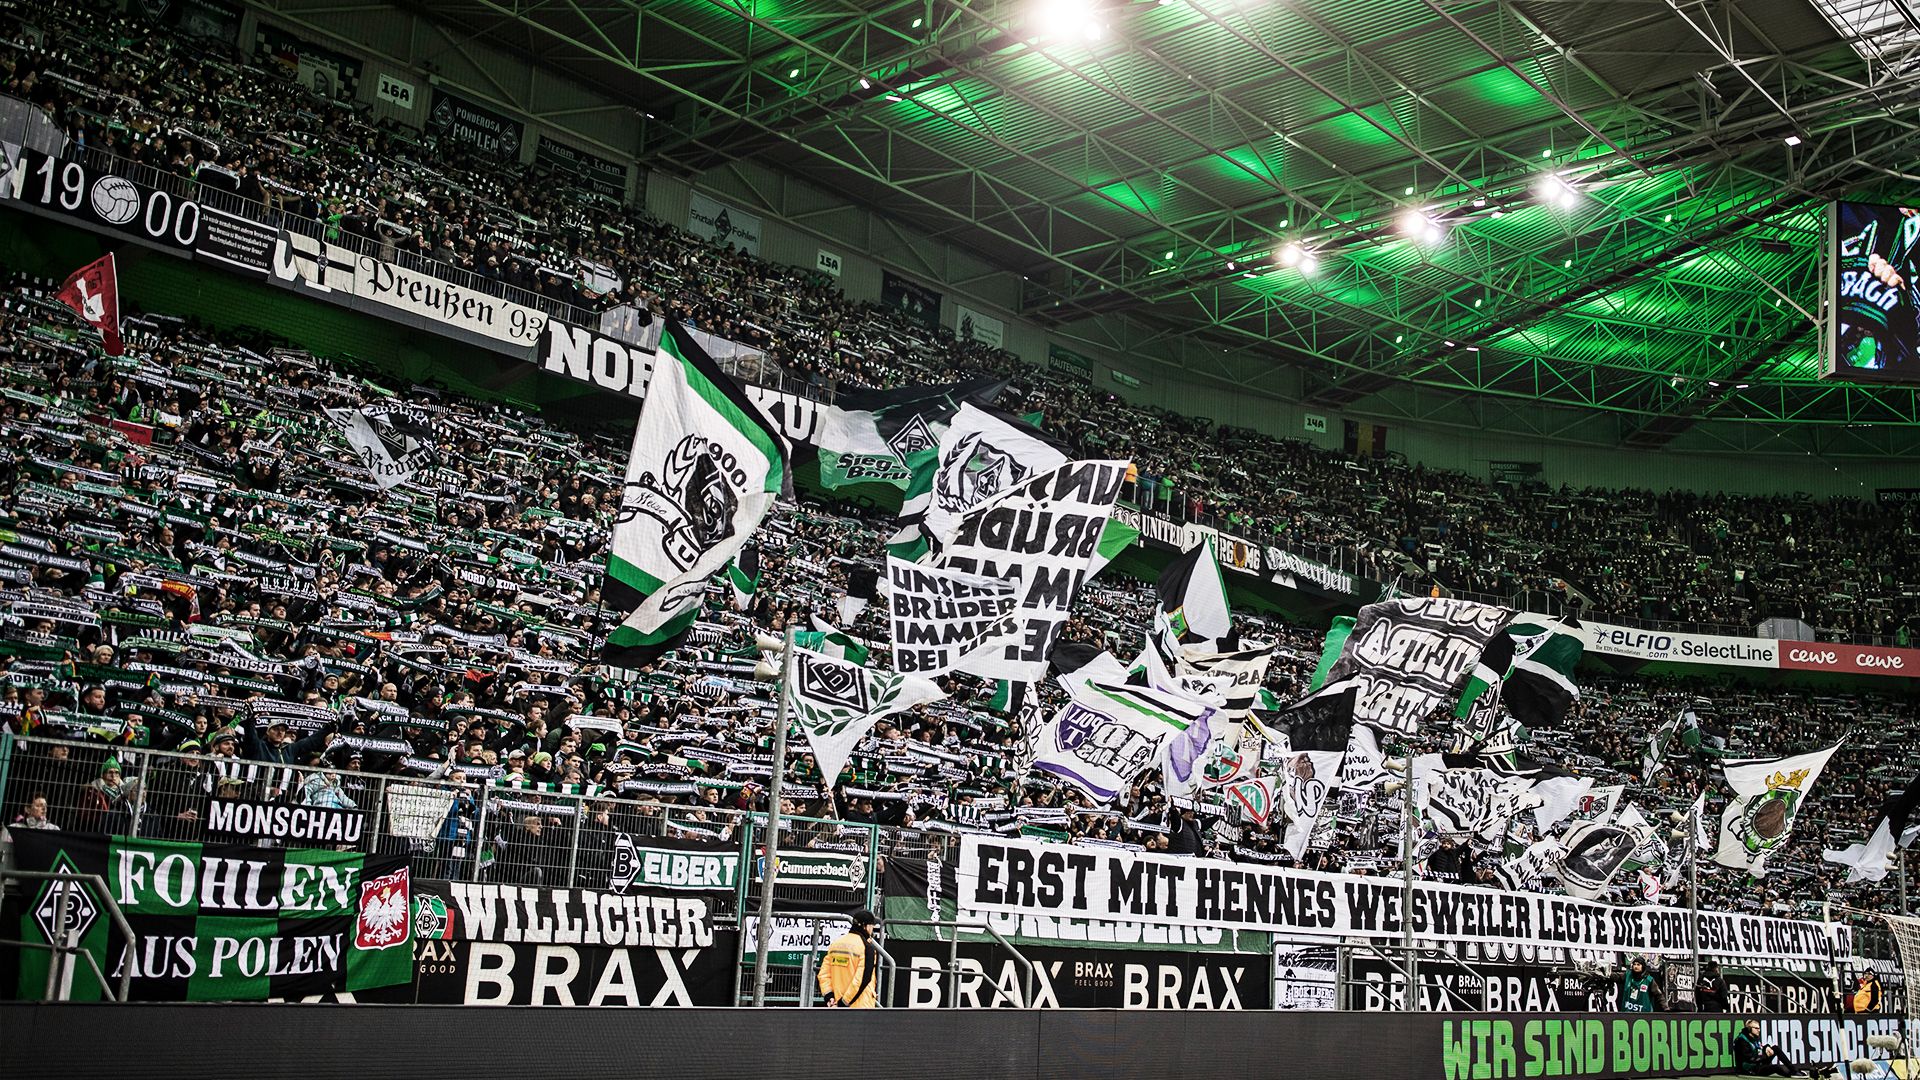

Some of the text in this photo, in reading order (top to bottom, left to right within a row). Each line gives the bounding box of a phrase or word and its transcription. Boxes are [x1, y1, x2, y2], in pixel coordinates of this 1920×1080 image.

[381, 81, 410, 102] 16A
[456, 106, 501, 133] PONDEROSA
[452, 122, 499, 151] FOHLEN
[37, 155, 85, 211] 19
[691, 208, 715, 227] Enztal
[731, 226, 757, 243] Fohlen
[819, 254, 839, 271] 15A
[359, 256, 494, 326] Preußen
[1306, 416, 1325, 431] 14A
[1141, 513, 1184, 548] UNITED
[49, 556, 81, 570] BORUSSIA
[460, 569, 486, 585] NORD
[13, 606, 95, 625] MÖNCHENGLADBACH
[893, 593, 1018, 620] BRÜDER
[322, 627, 337, 636] BIN
[897, 649, 949, 673] BEI
[1646, 651, 1670, 659] .com
[1672, 640, 1773, 661] & SelectLine
[1789, 648, 1904, 669] cewe cewe
[208, 652, 284, 675] BORUSSIA
[395, 715, 409, 725] BIN
[208, 800, 364, 843] MONSCHAU
[116, 848, 363, 912] FOHLEN
[643, 851, 739, 887] ELBERT
[779, 860, 850, 877] Gummersbach
[365, 871, 407, 892] POLSKA
[974, 843, 1097, 910] ERST
[1107, 857, 1186, 918] MIT
[1195, 868, 1337, 929] HENNES
[1536, 899, 1608, 945] LEGTE
[1612, 908, 1646, 949] DIE
[1649, 911, 1738, 952] BORUSSIA
[1740, 916, 1762, 954] SO
[1765, 919, 1828, 956] RICHTIG
[450, 881, 714, 948] WILLICHER
[775, 917, 800, 929] MAX
[112, 932, 344, 979] AUS POLEN
[420, 964, 456, 974] GOOD
[464, 941, 701, 1008] BRAX
[1074, 961, 1114, 979] BRAX
[909, 956, 1063, 1009] BRAX
[1074, 979, 1114, 988] FEEL GOOD
[1123, 963, 1246, 1010] BRAX
[1365, 972, 1454, 1012] BRAX
[1458, 975, 1482, 988] BRAX
[1487, 976, 1561, 1013] BRAX
[1787, 985, 1830, 1014] BRAX
[1442, 1019, 1516, 1080] WIR
[1524, 1018, 1606, 1077] SIND
[1760, 1019, 1806, 1066] WIR
